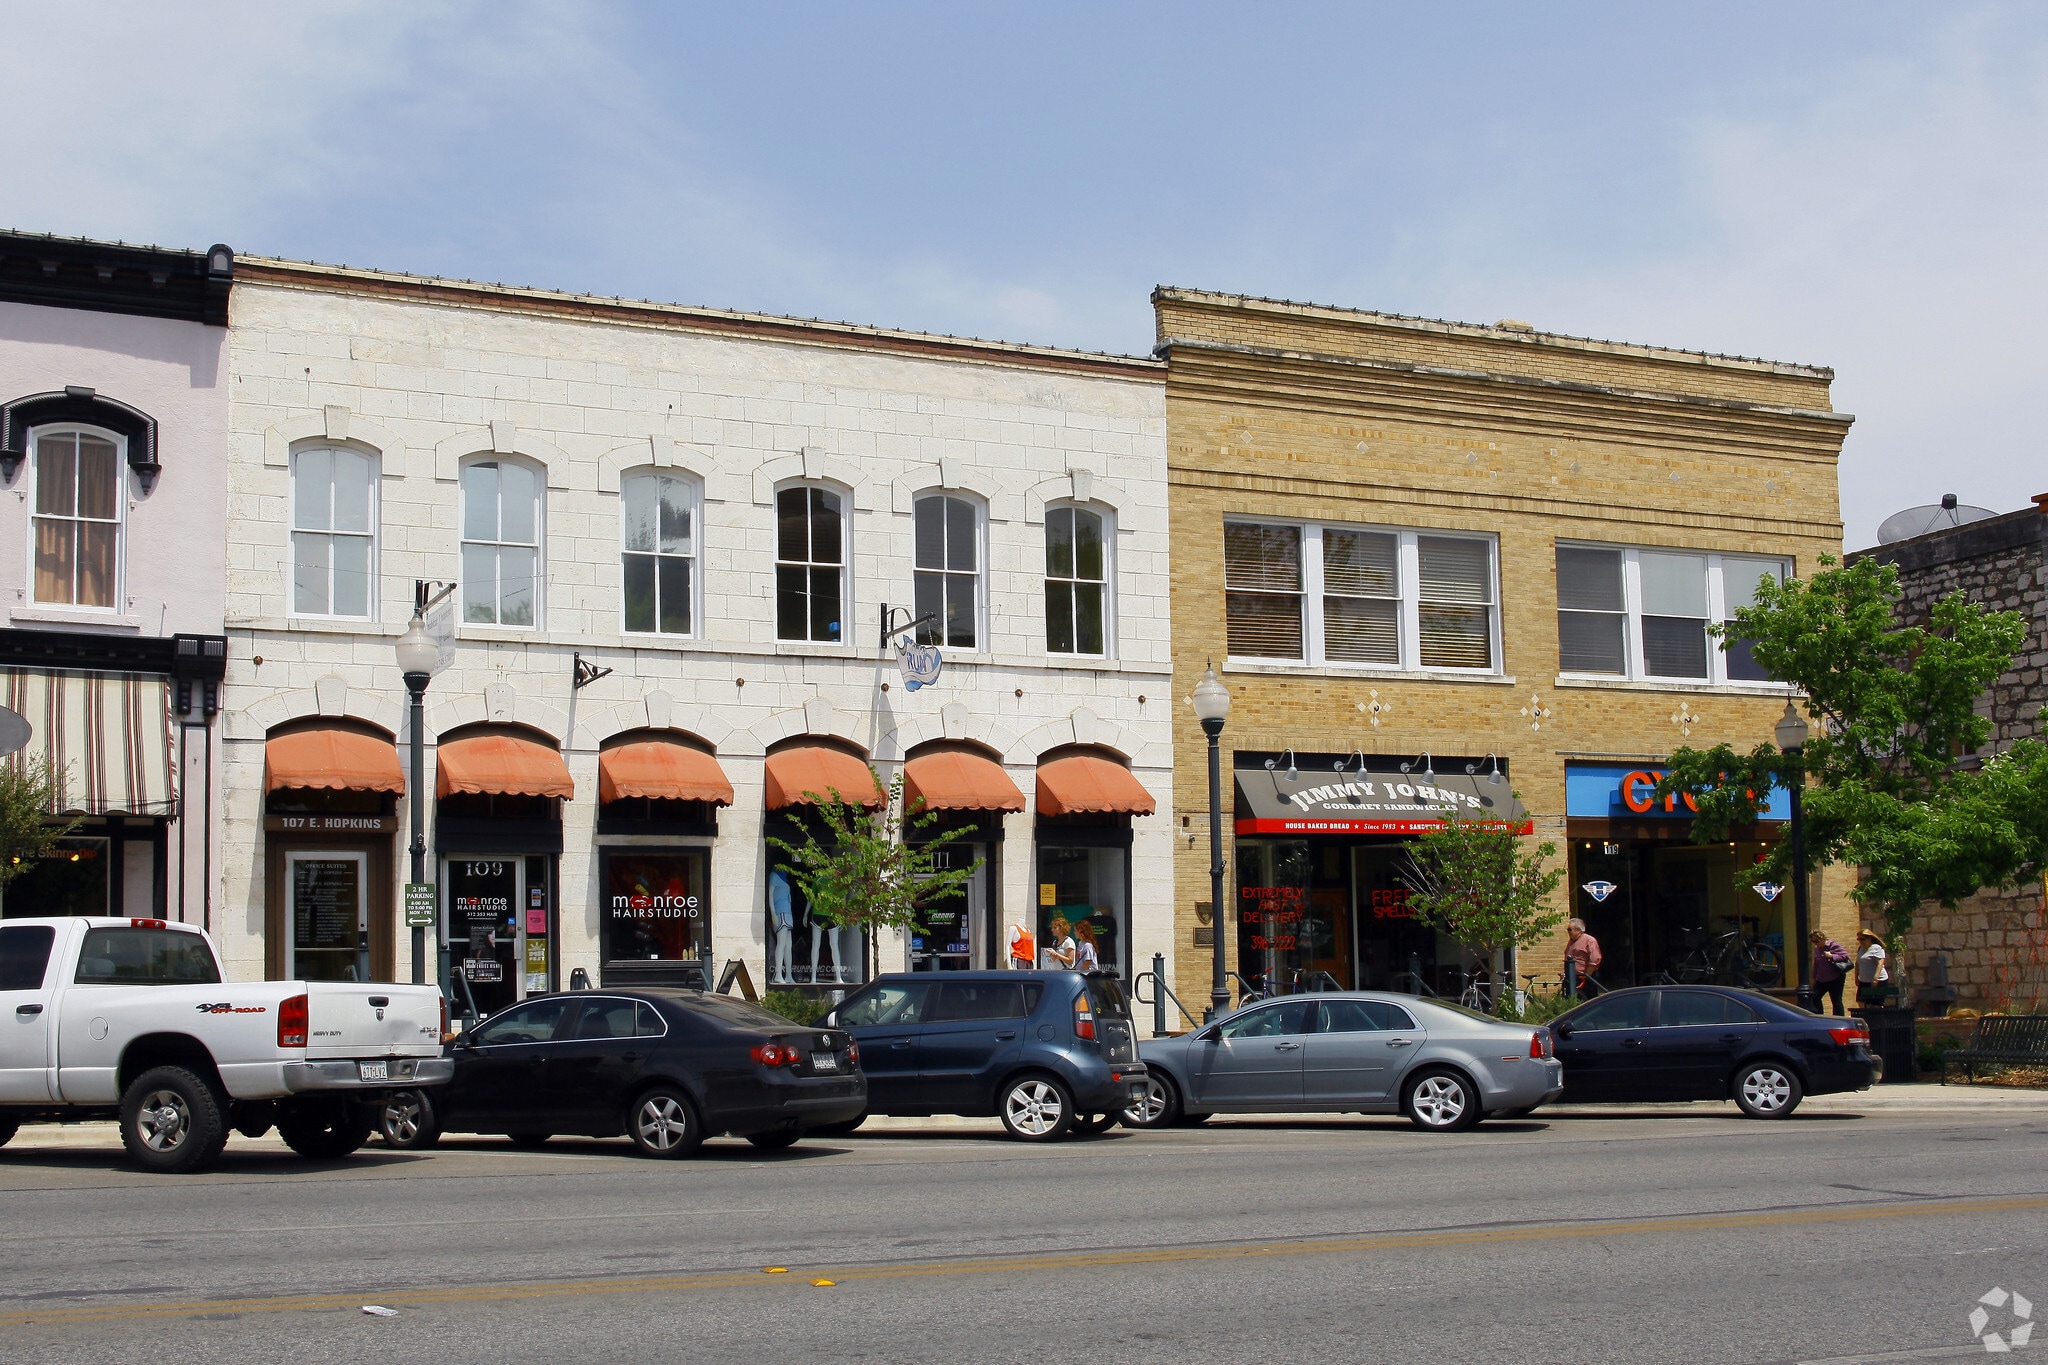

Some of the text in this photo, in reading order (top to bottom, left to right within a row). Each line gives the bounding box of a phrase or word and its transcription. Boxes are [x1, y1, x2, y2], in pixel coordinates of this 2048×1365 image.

[906, 651, 927, 672] RUN
[1289, 782, 1481, 812] JIMMY JOHN'S
[282, 817, 381, 829] 107 E. HOPKINS
[79, 848, 97, 861] Dip
[1605, 846, 1619, 855] 119
[930, 851, 951, 869] 111
[465, 861, 503, 877] 109
[1242, 887, 1304, 899] EXTREMELY
[613, 908, 699, 918] HAIRSTUDIO
[1243, 911, 1303, 923] DELIVERY
[1373, 903, 1417, 919] SMELLS
